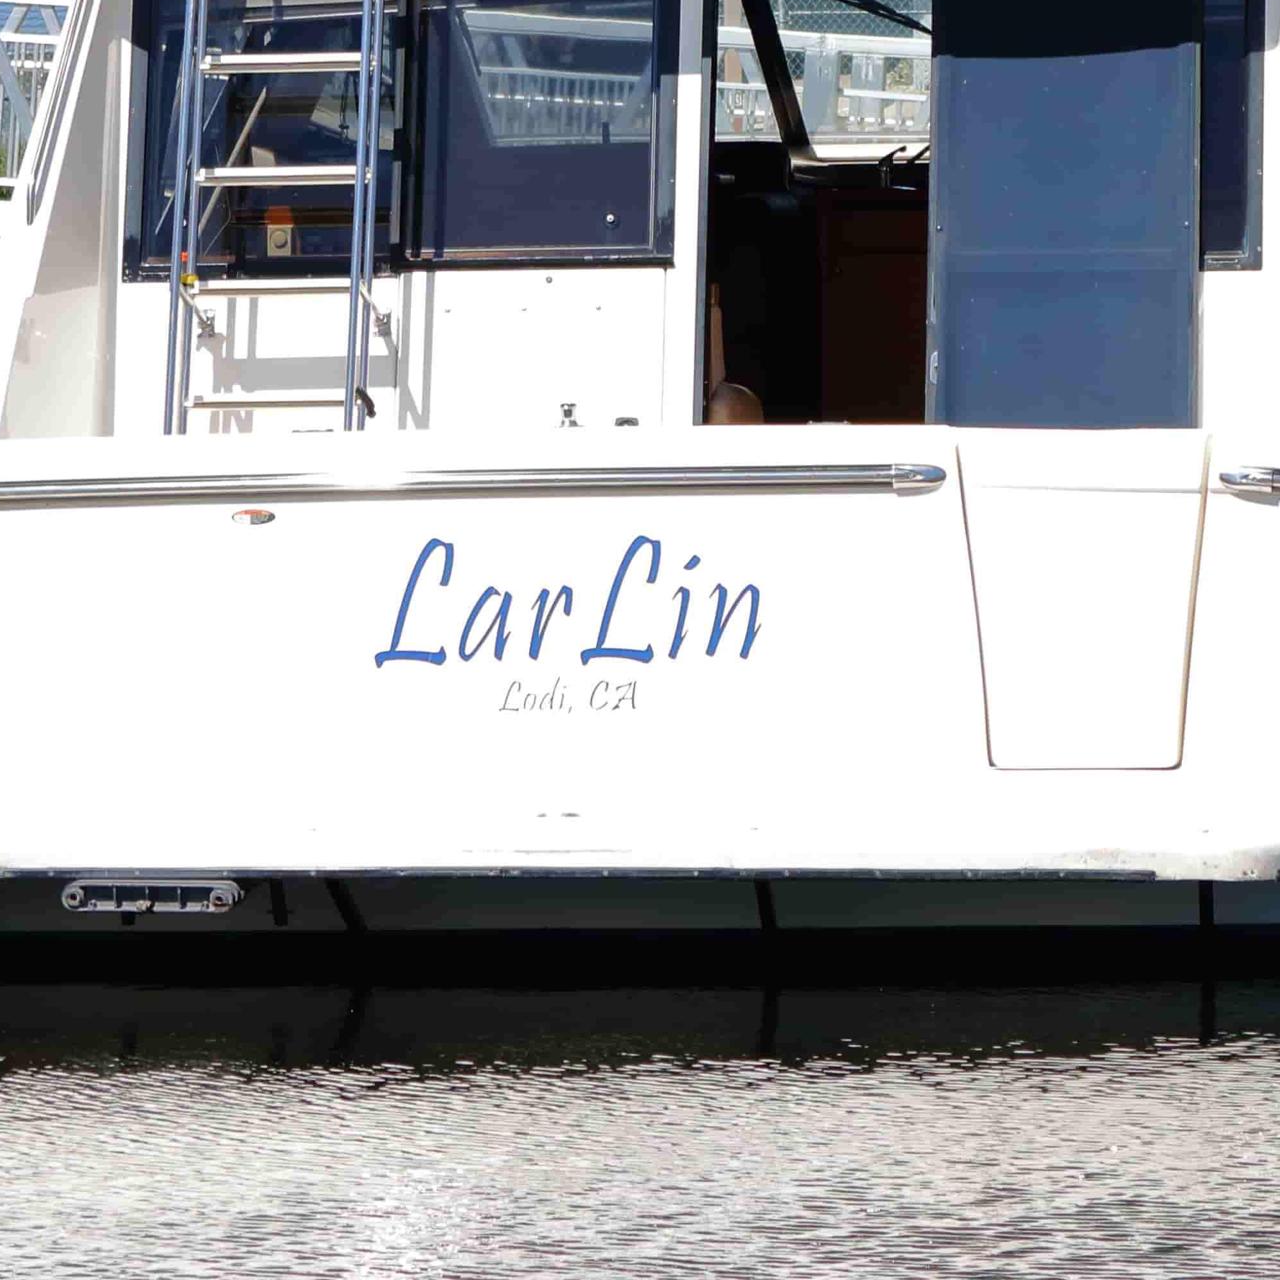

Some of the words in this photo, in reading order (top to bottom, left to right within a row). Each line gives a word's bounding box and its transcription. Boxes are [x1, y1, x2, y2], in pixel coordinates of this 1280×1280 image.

[375, 535, 761, 668] LarLin
[499, 677, 573, 714] Lodi,
[590, 680, 638, 711] CA
